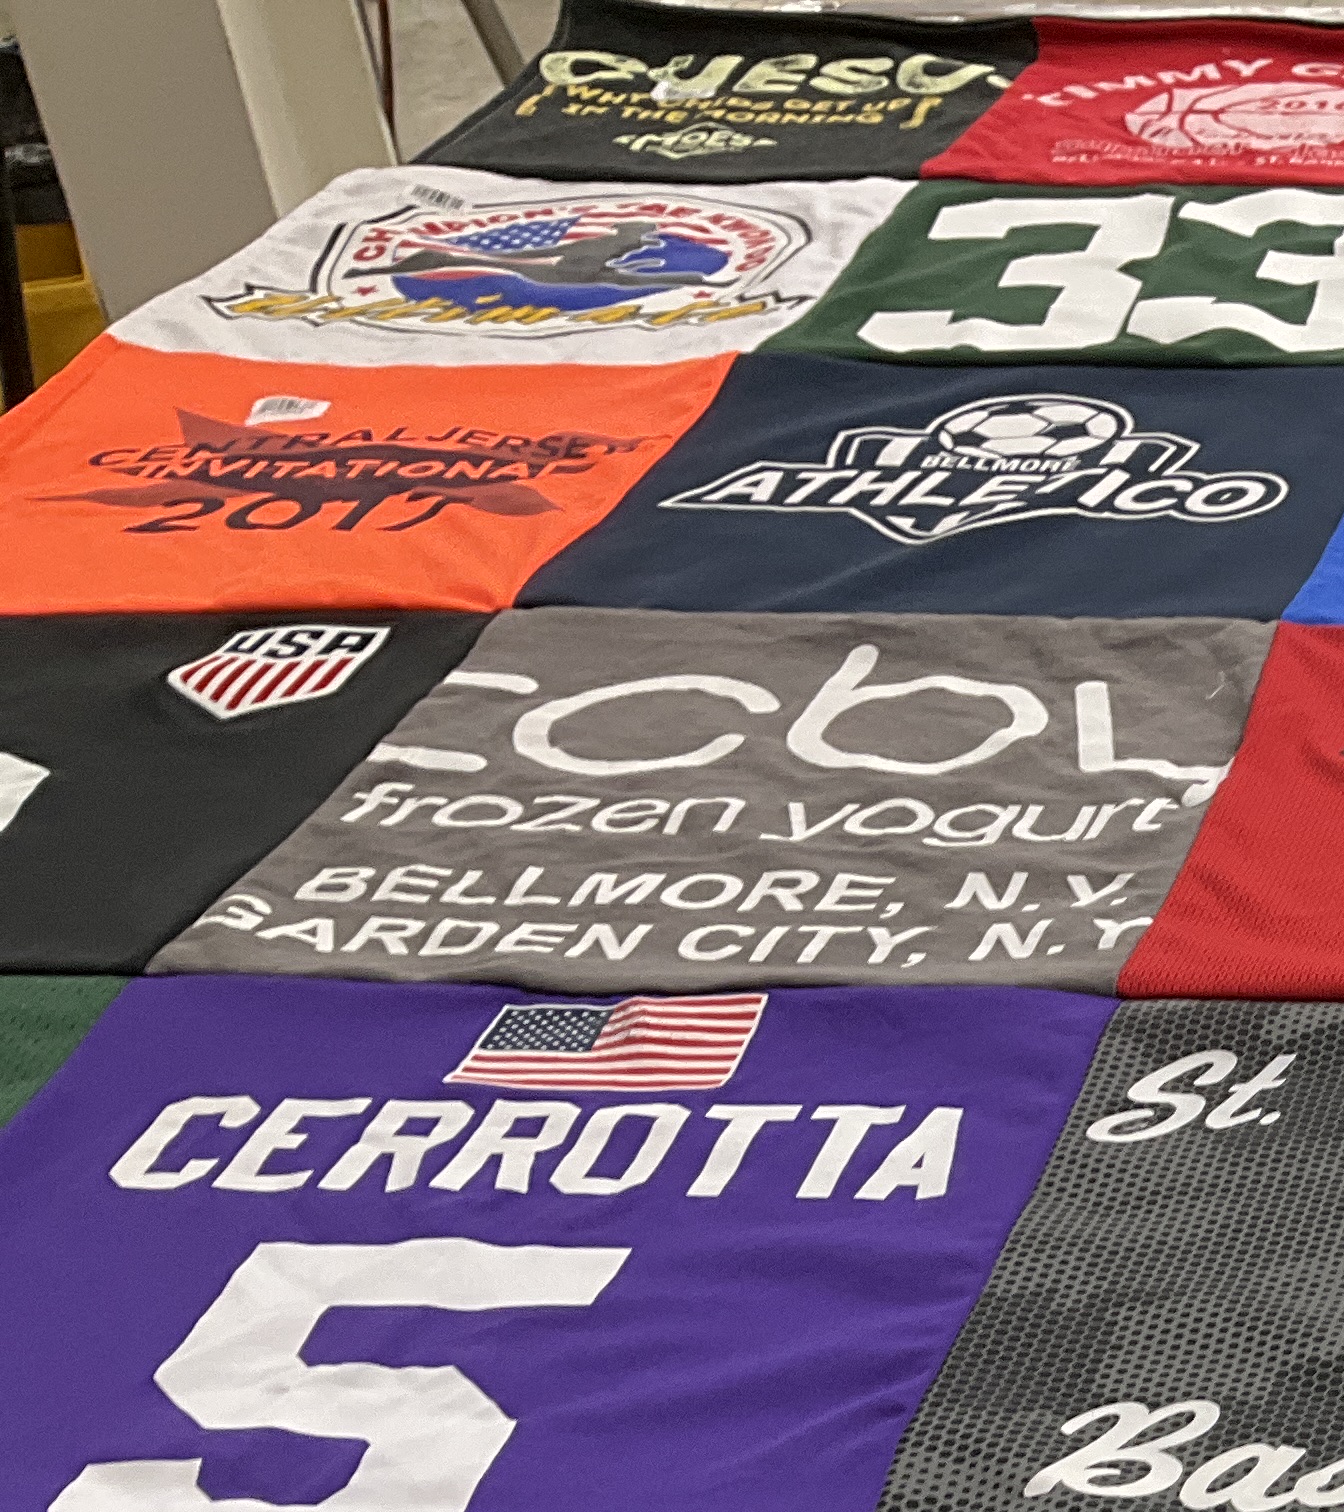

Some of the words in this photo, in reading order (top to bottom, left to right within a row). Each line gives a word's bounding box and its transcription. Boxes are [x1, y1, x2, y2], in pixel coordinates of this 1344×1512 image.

[87, 426, 408, 467] CENTRAL
[137, 456, 570, 480] INVITATIONAL
[122, 494, 460, 534] 2017
[226, 629, 366, 660] USA
[339, 782, 743, 836] frozen
[757, 791, 1190, 848] yogurt
[293, 864, 906, 917] BELLMORE,
[945, 869, 1131, 910] N.Y.
[677, 921, 931, 968] CITY,
[1085, 1048, 1298, 1144] St.
[108, 1093, 965, 1201] CERROTTA
